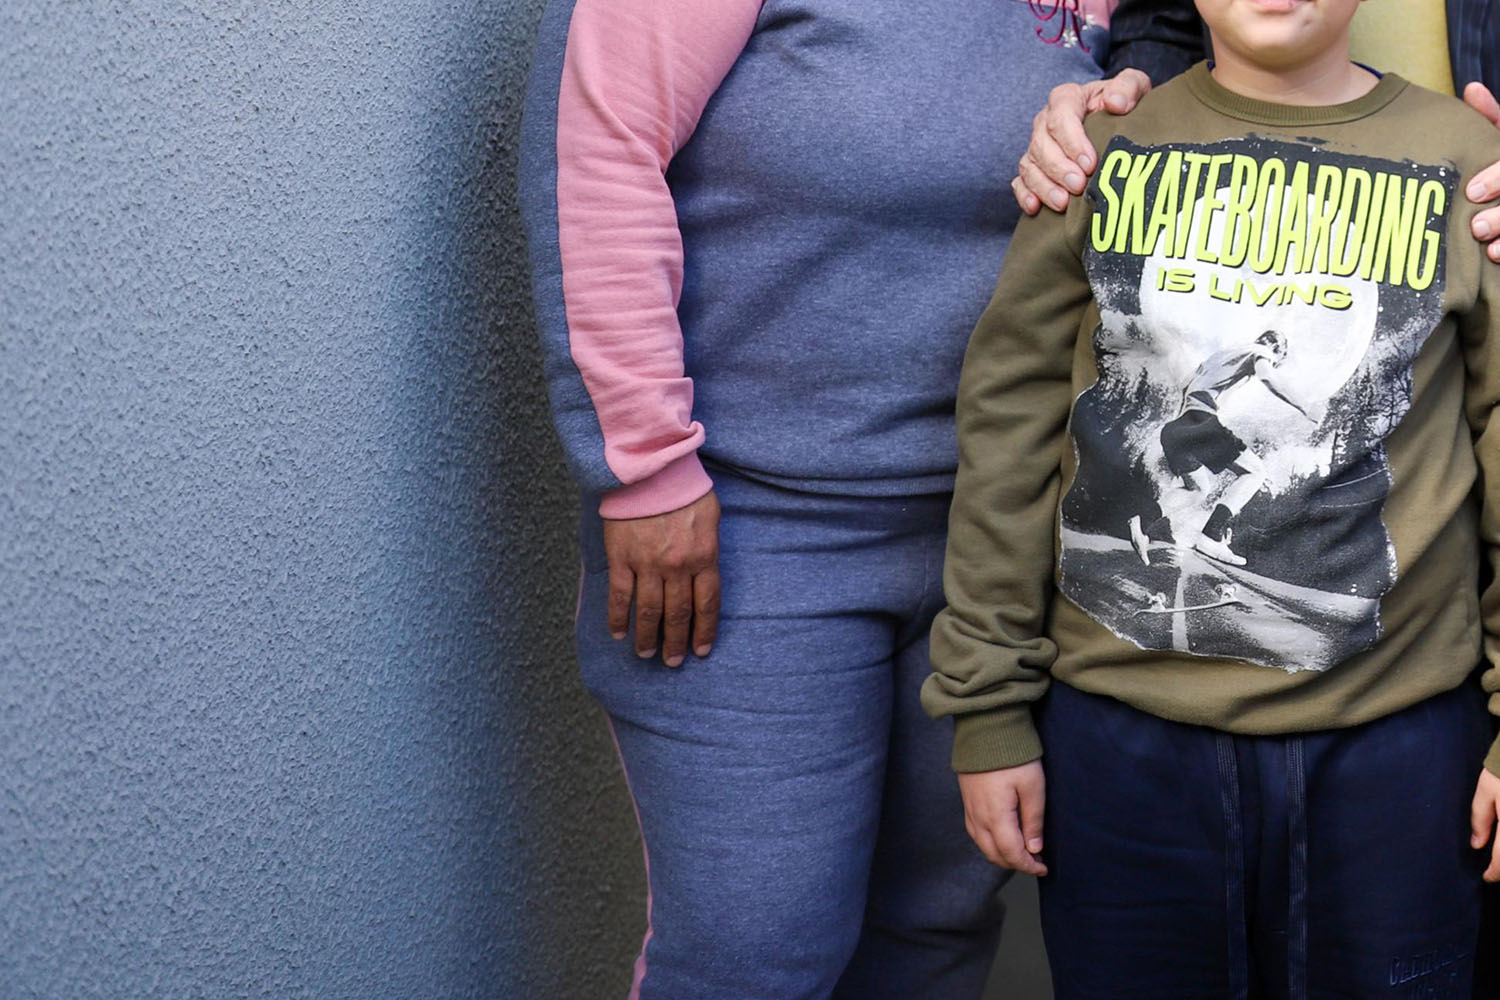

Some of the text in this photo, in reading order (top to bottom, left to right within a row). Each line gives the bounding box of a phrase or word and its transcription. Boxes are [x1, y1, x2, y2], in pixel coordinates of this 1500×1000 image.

[1091, 149, 1446, 291] SKATEBOARDING
[1157, 267, 1353, 310] IS LIVING
